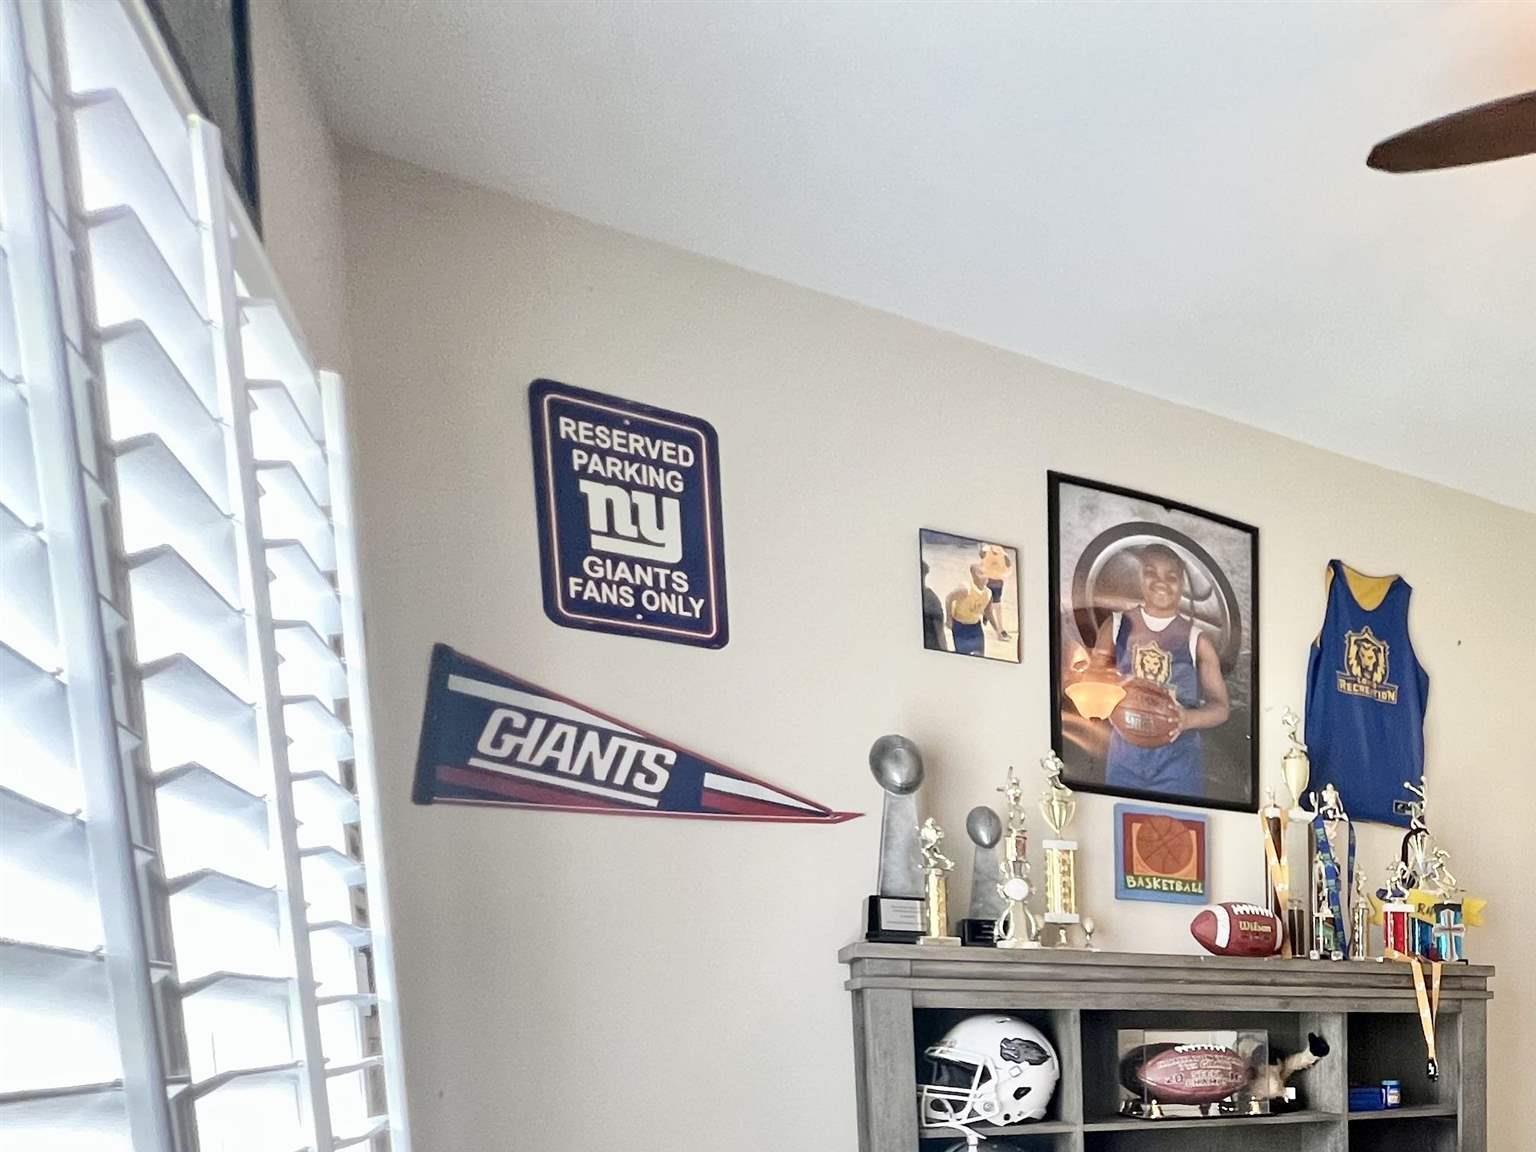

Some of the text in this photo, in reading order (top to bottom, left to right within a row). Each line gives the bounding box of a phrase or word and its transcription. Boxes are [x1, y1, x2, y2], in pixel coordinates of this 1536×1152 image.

[559, 416, 695, 468] RESERVED
[572, 449, 684, 493] PARKING
[578, 478, 683, 564] ny
[582, 555, 689, 593] GIANTS
[568, 576, 705, 619] FANS ONLY
[476, 708, 678, 794] GIANTS
[1126, 875, 1204, 894] BASKETBALL
[1239, 920, 1272, 934] Wilson
